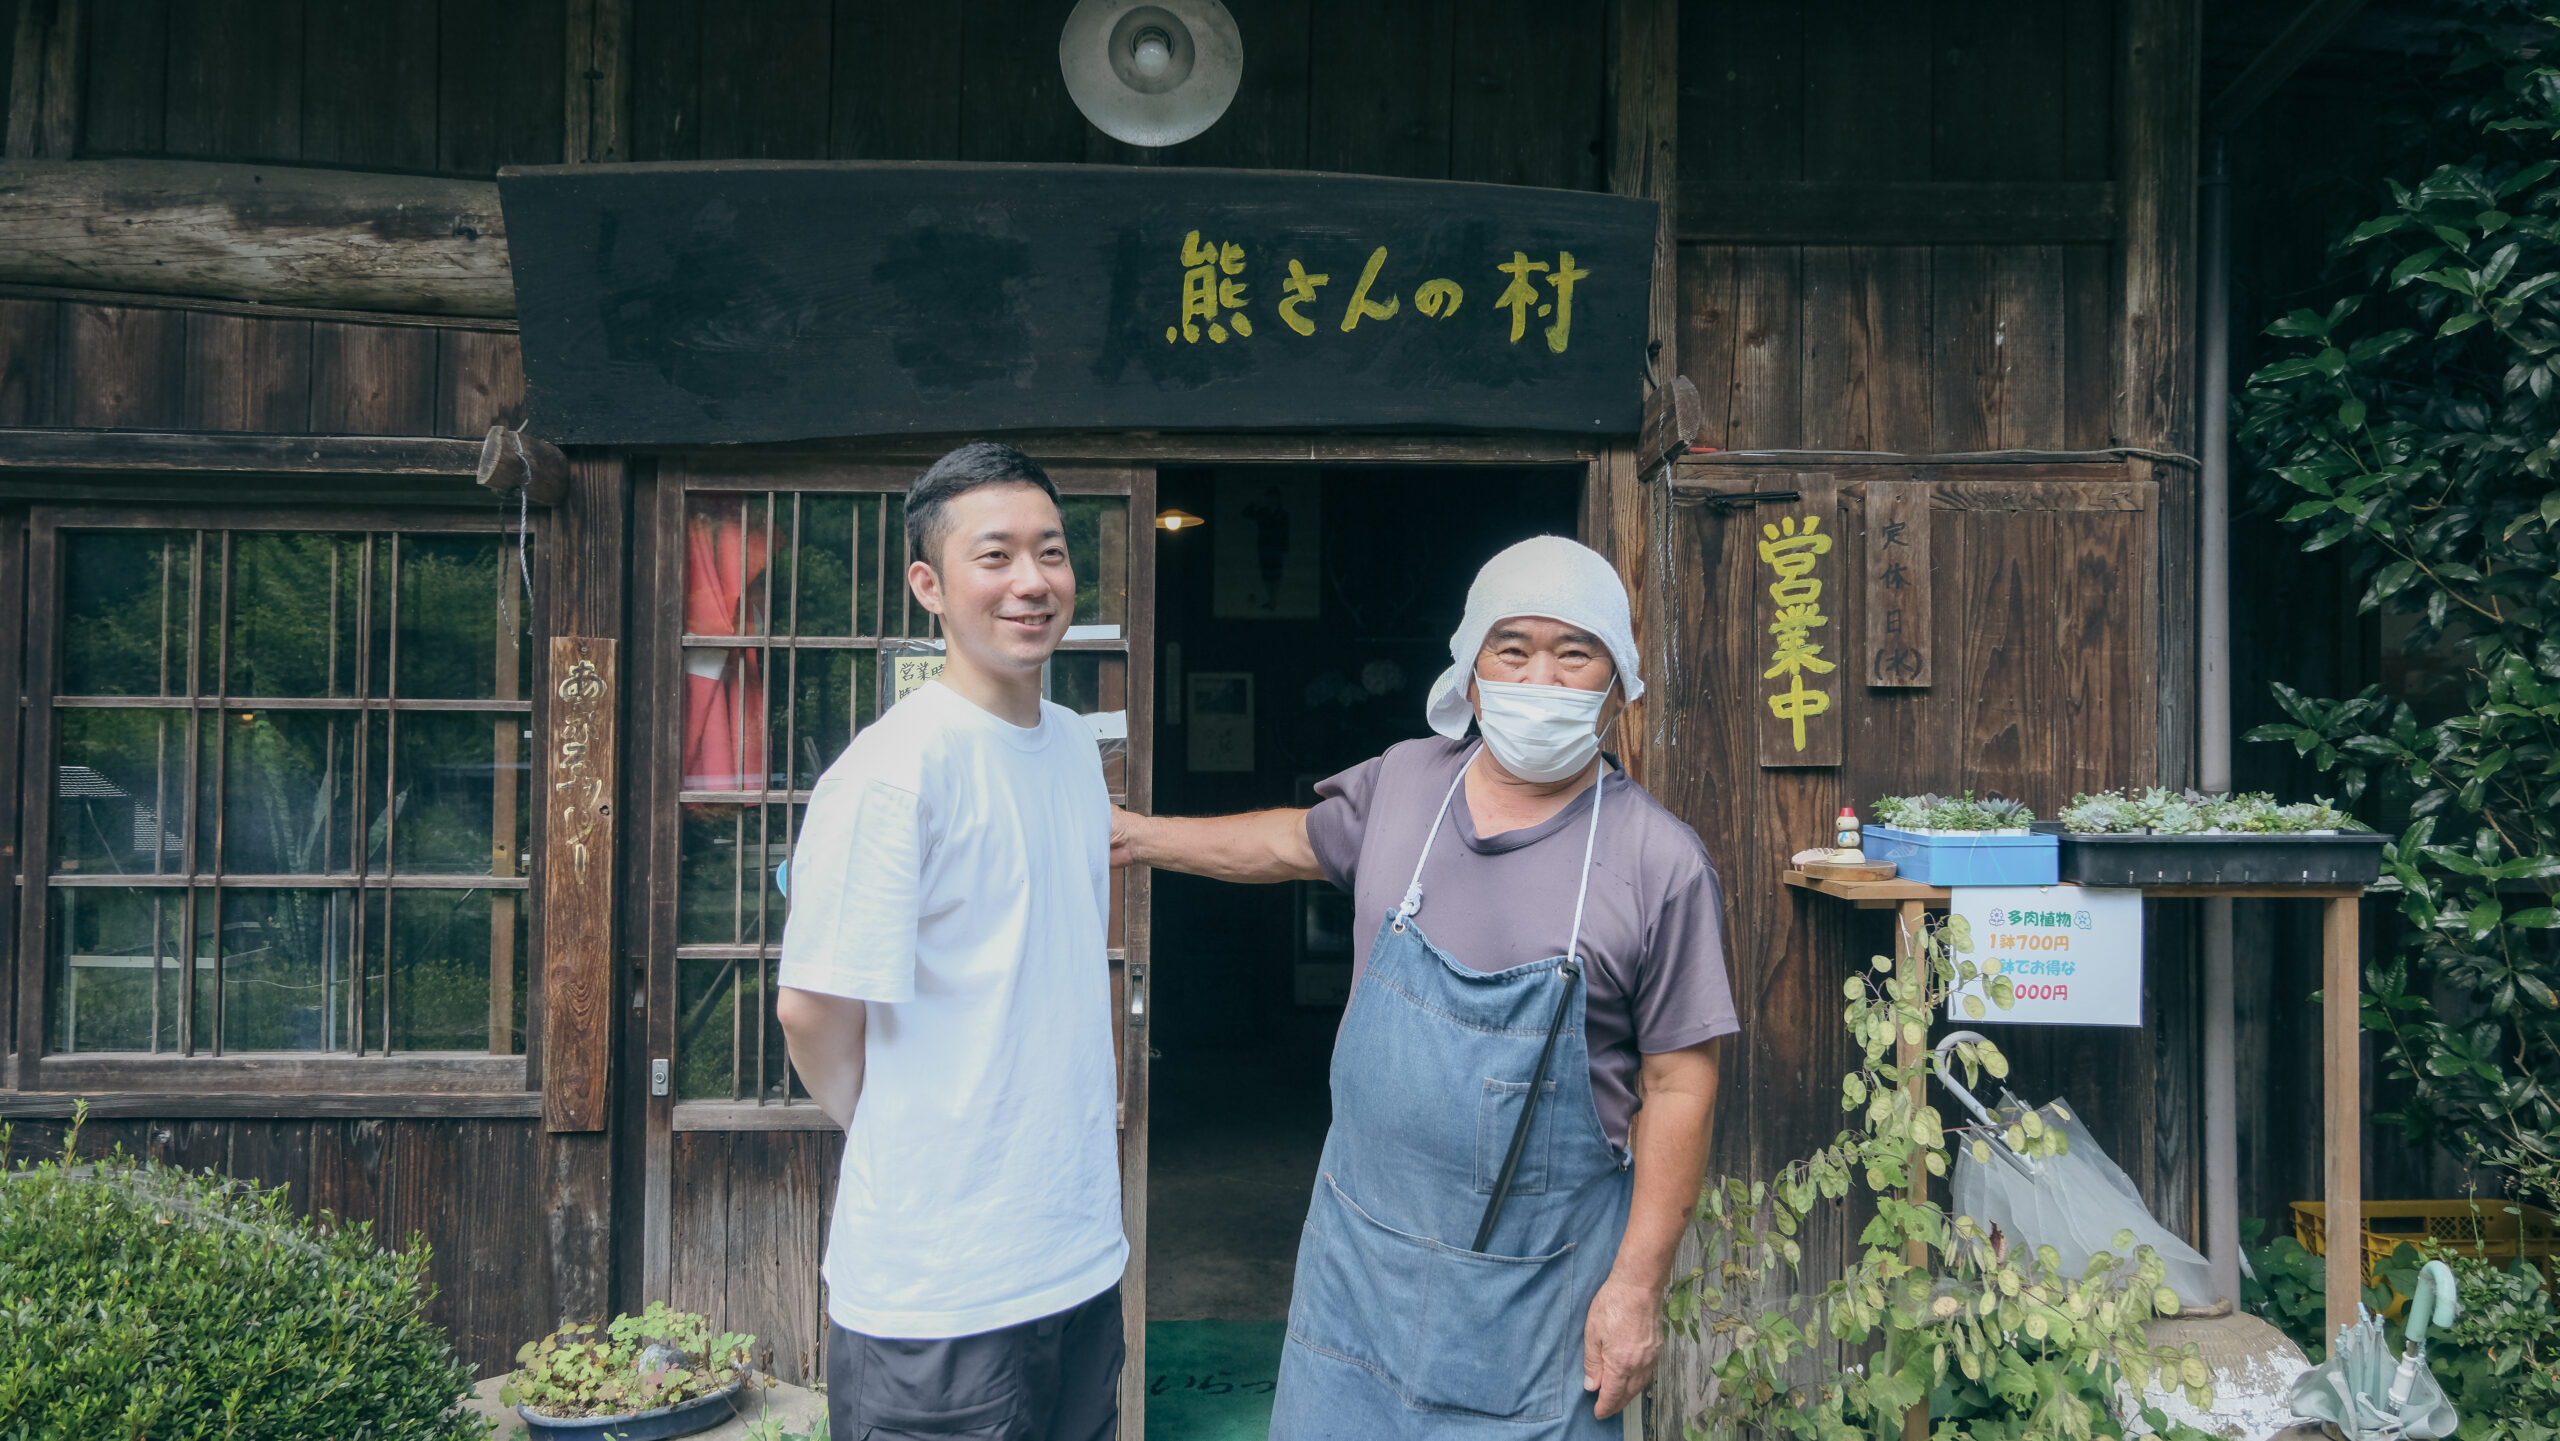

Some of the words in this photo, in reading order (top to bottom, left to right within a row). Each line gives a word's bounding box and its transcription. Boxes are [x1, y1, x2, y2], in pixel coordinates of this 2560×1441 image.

[1166, 230, 1591, 352] 熊さんの村
[1759, 516, 1837, 752] 営業中
[2008, 910, 2072, 927] 多肉植物
[1990, 934, 2069, 951] 1鉢700円
[1999, 959, 2075, 976] 鉢でお得な
[2014, 984, 2068, 1000] 000円
